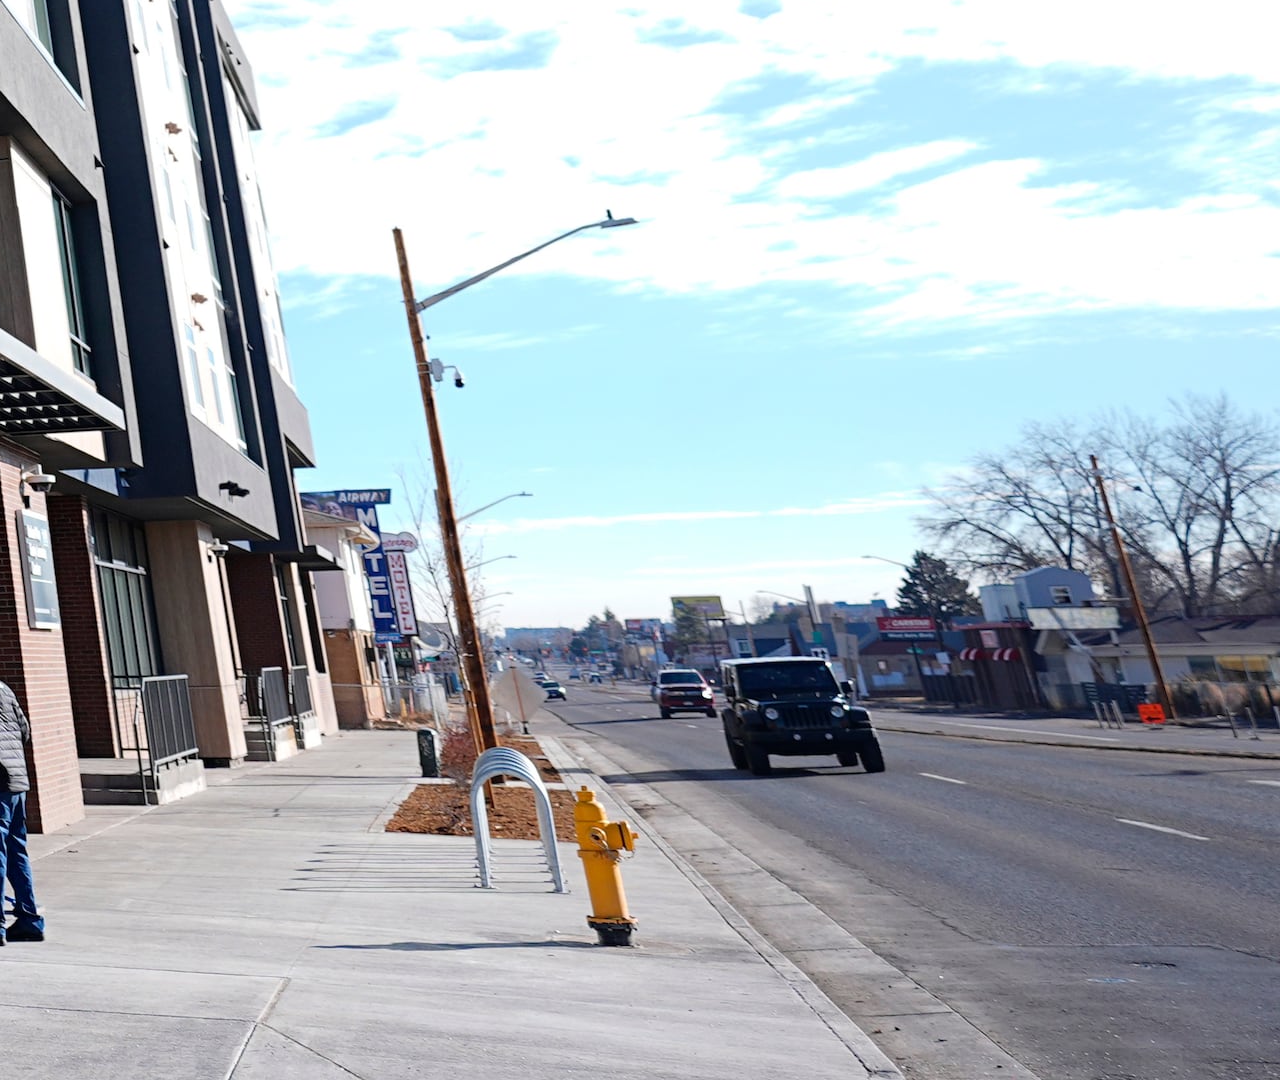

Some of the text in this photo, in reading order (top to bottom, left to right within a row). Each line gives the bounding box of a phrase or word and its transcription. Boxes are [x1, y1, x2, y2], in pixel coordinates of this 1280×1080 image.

[338, 491, 388, 503] AIRWAY
[356, 507, 393, 618] MTEL
[390, 554, 413, 631] MOTEL
